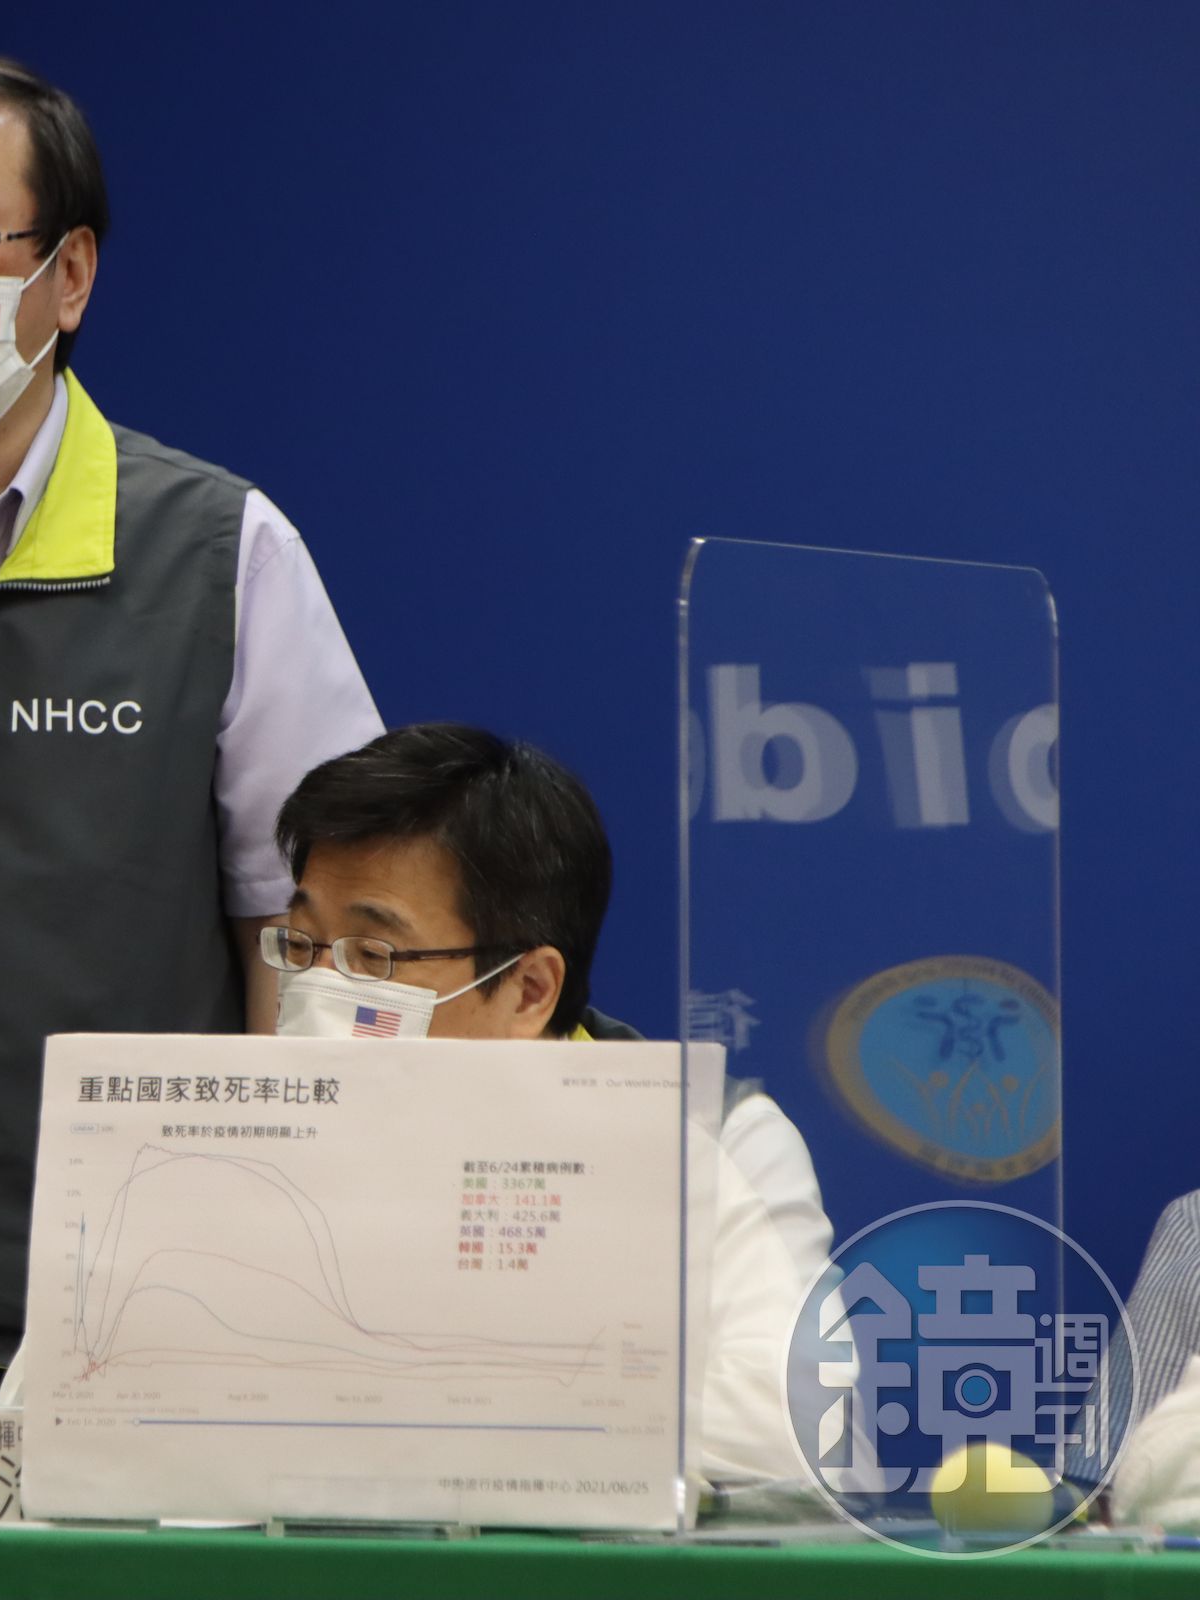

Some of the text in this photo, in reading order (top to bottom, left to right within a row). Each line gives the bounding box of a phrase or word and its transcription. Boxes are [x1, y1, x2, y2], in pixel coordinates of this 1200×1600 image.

[11, 698, 143, 735] NHCC
[78, 1076, 340, 1105] 重點國家致死率比較
[161, 1124, 318, 1139] 致死率於疫情初期明顯上升
[575, 1480, 649, 1495] 2021/06/25
